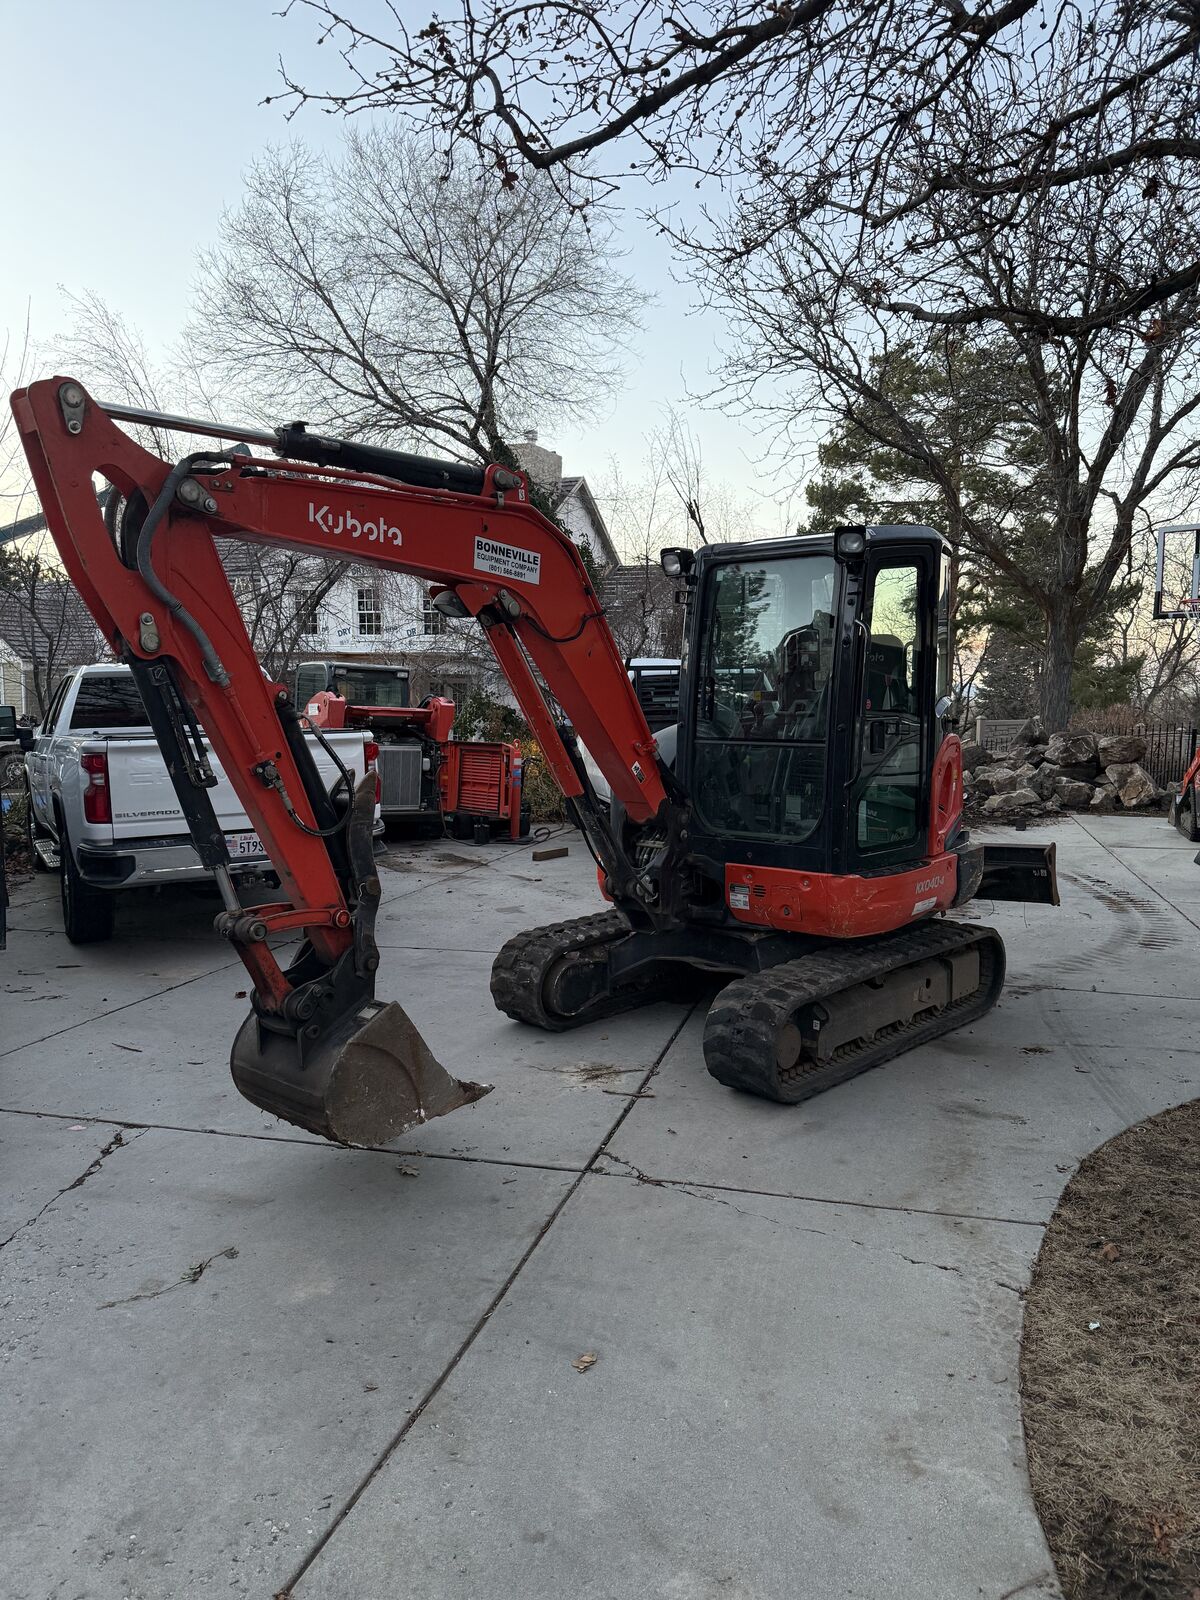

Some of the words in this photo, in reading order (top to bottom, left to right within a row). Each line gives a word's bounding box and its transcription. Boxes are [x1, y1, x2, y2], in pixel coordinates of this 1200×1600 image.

[309, 502, 402, 546] Kubota
[476, 540, 539, 566] BONNEVILLE
[477, 552, 510, 567] EQUIPMENT
[510, 561, 538, 574] COMPANY
[488, 564, 503, 574] (801)
[337, 627, 352, 637] DRY
[115, 810, 180, 819] SILVERADO
